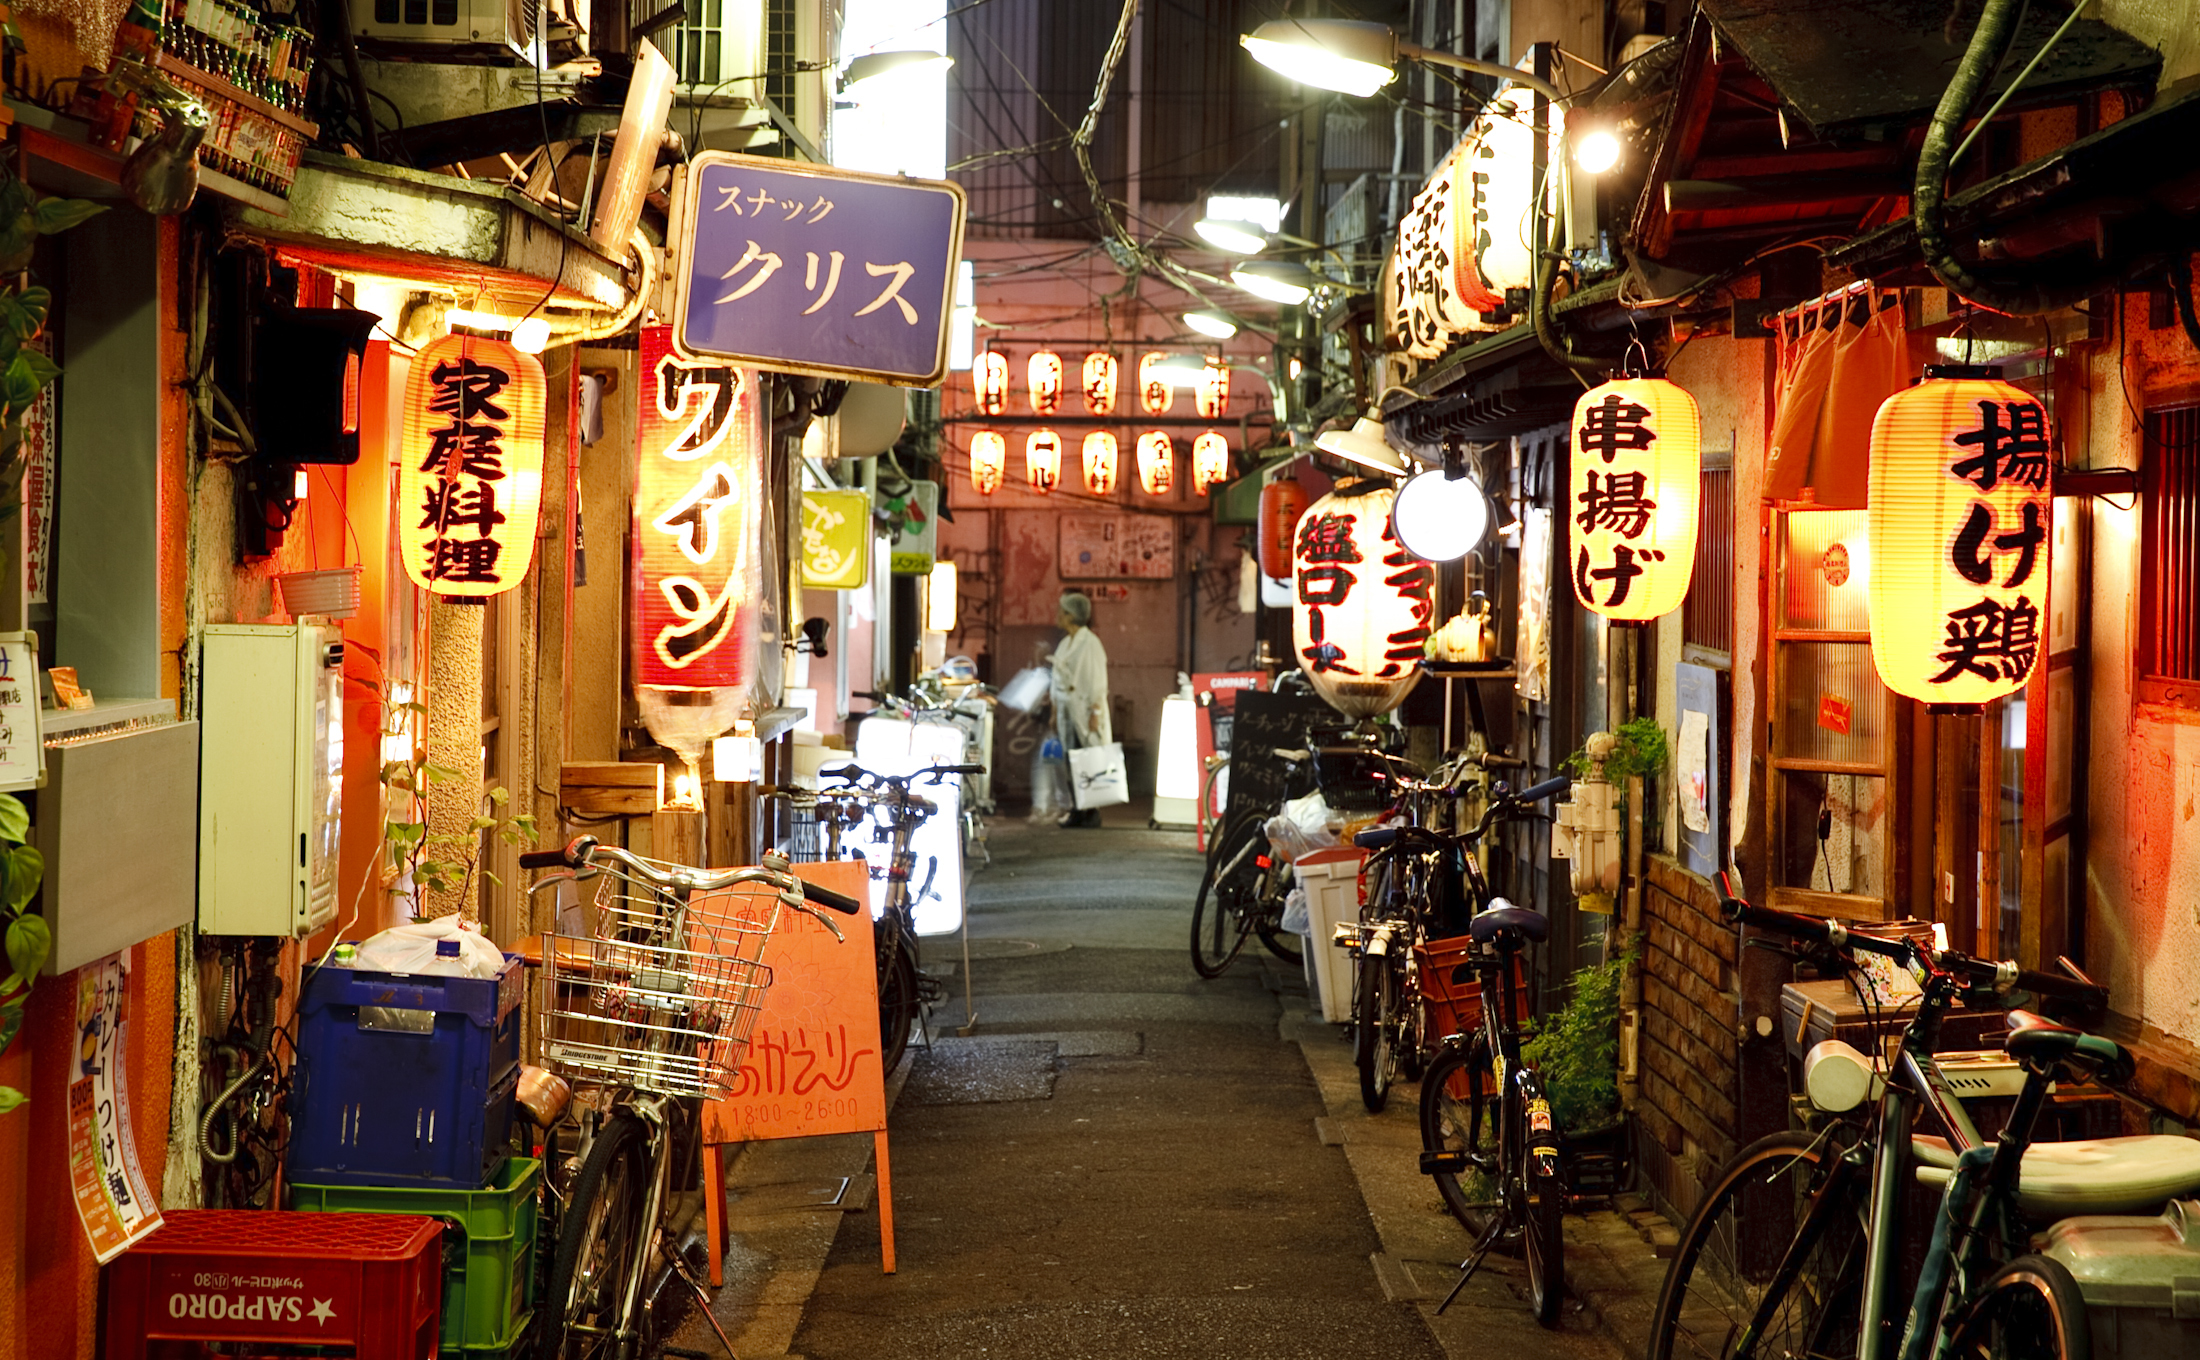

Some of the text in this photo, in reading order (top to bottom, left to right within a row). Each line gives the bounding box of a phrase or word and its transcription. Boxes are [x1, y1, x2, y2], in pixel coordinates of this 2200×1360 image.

[714, 186, 835, 225] スナック
[713, 240, 919, 326] クリス
[416, 357, 511, 583] 家庭料理
[653, 354, 745, 669] ワイン
[1576, 394, 1666, 608] 串揚げ
[1928, 399, 2049, 685] 揚げ鶏
[561, 1048, 608, 1062] BRIDGESTONE
[169, 1293, 303, 1322] SAPPORO
